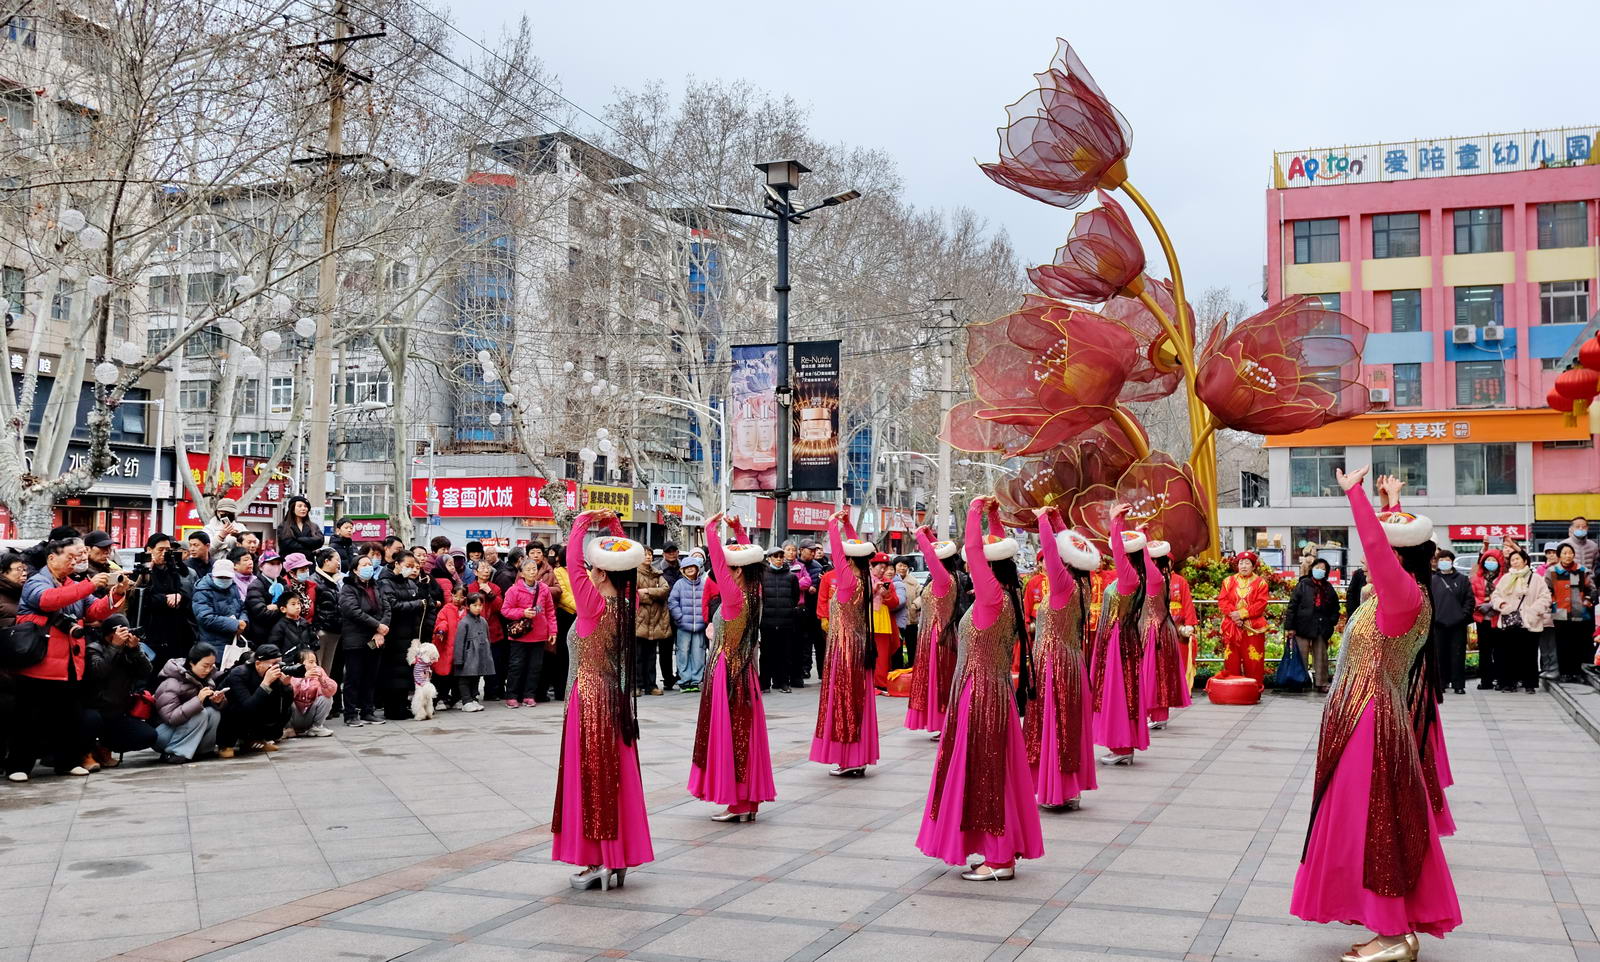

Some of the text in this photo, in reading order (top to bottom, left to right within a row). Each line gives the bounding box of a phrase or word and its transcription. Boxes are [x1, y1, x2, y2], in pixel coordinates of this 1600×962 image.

[1384, 134, 1592, 174] 爱陪童幼儿园
[11, 354, 52, 373] 美腔
[800, 354, 833, 363] Re-Nutriv
[1396, 422, 1447, 440] 豪享来
[69, 453, 140, 478] 水家纺
[442, 486, 513, 508] 蜜雪冰城
